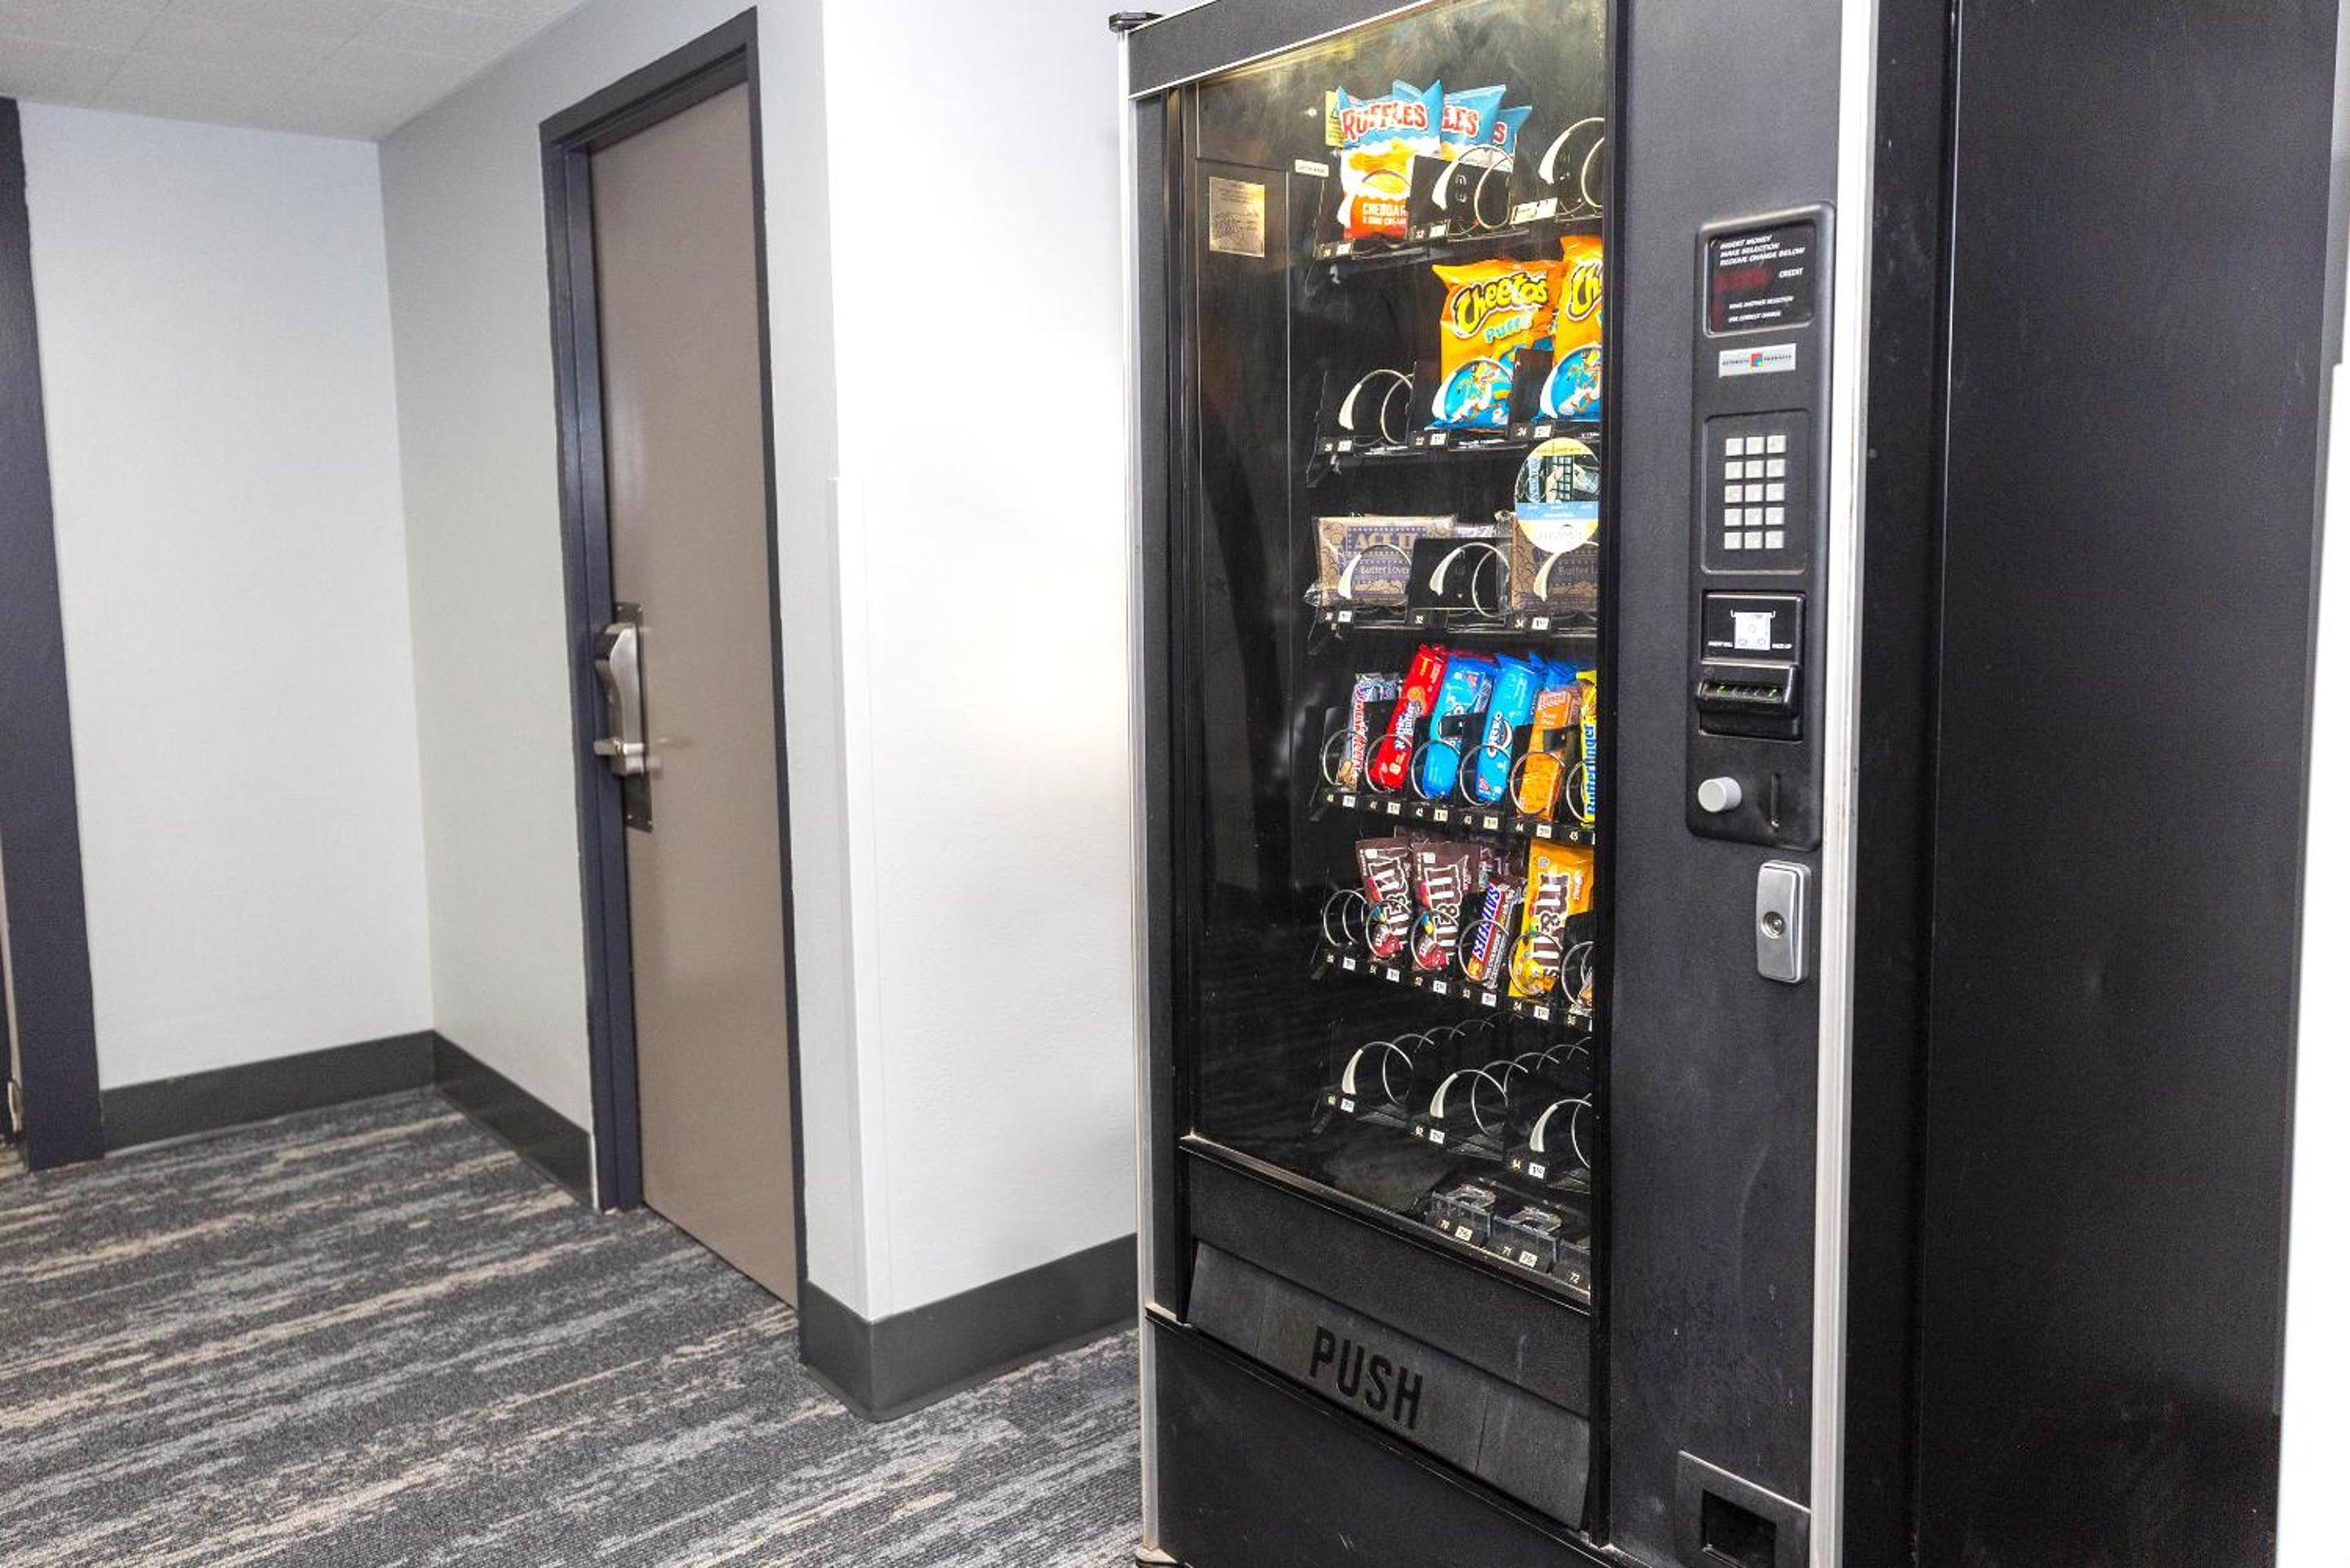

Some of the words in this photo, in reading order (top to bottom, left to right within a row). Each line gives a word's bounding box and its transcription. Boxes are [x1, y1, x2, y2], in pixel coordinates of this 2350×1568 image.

[1342, 104, 1427, 139] RUFFLES
[1720, 239, 1746, 250] INSERT
[1746, 235, 1772, 245] MONEY
[1720, 250, 1740, 259] MAKE
[1741, 242, 1780, 255] SELECTION
[1778, 247, 1806, 257] BELOW
[1779, 268, 1804, 278] CREDIT
[1309, 1325, 1423, 1430] PUSH
